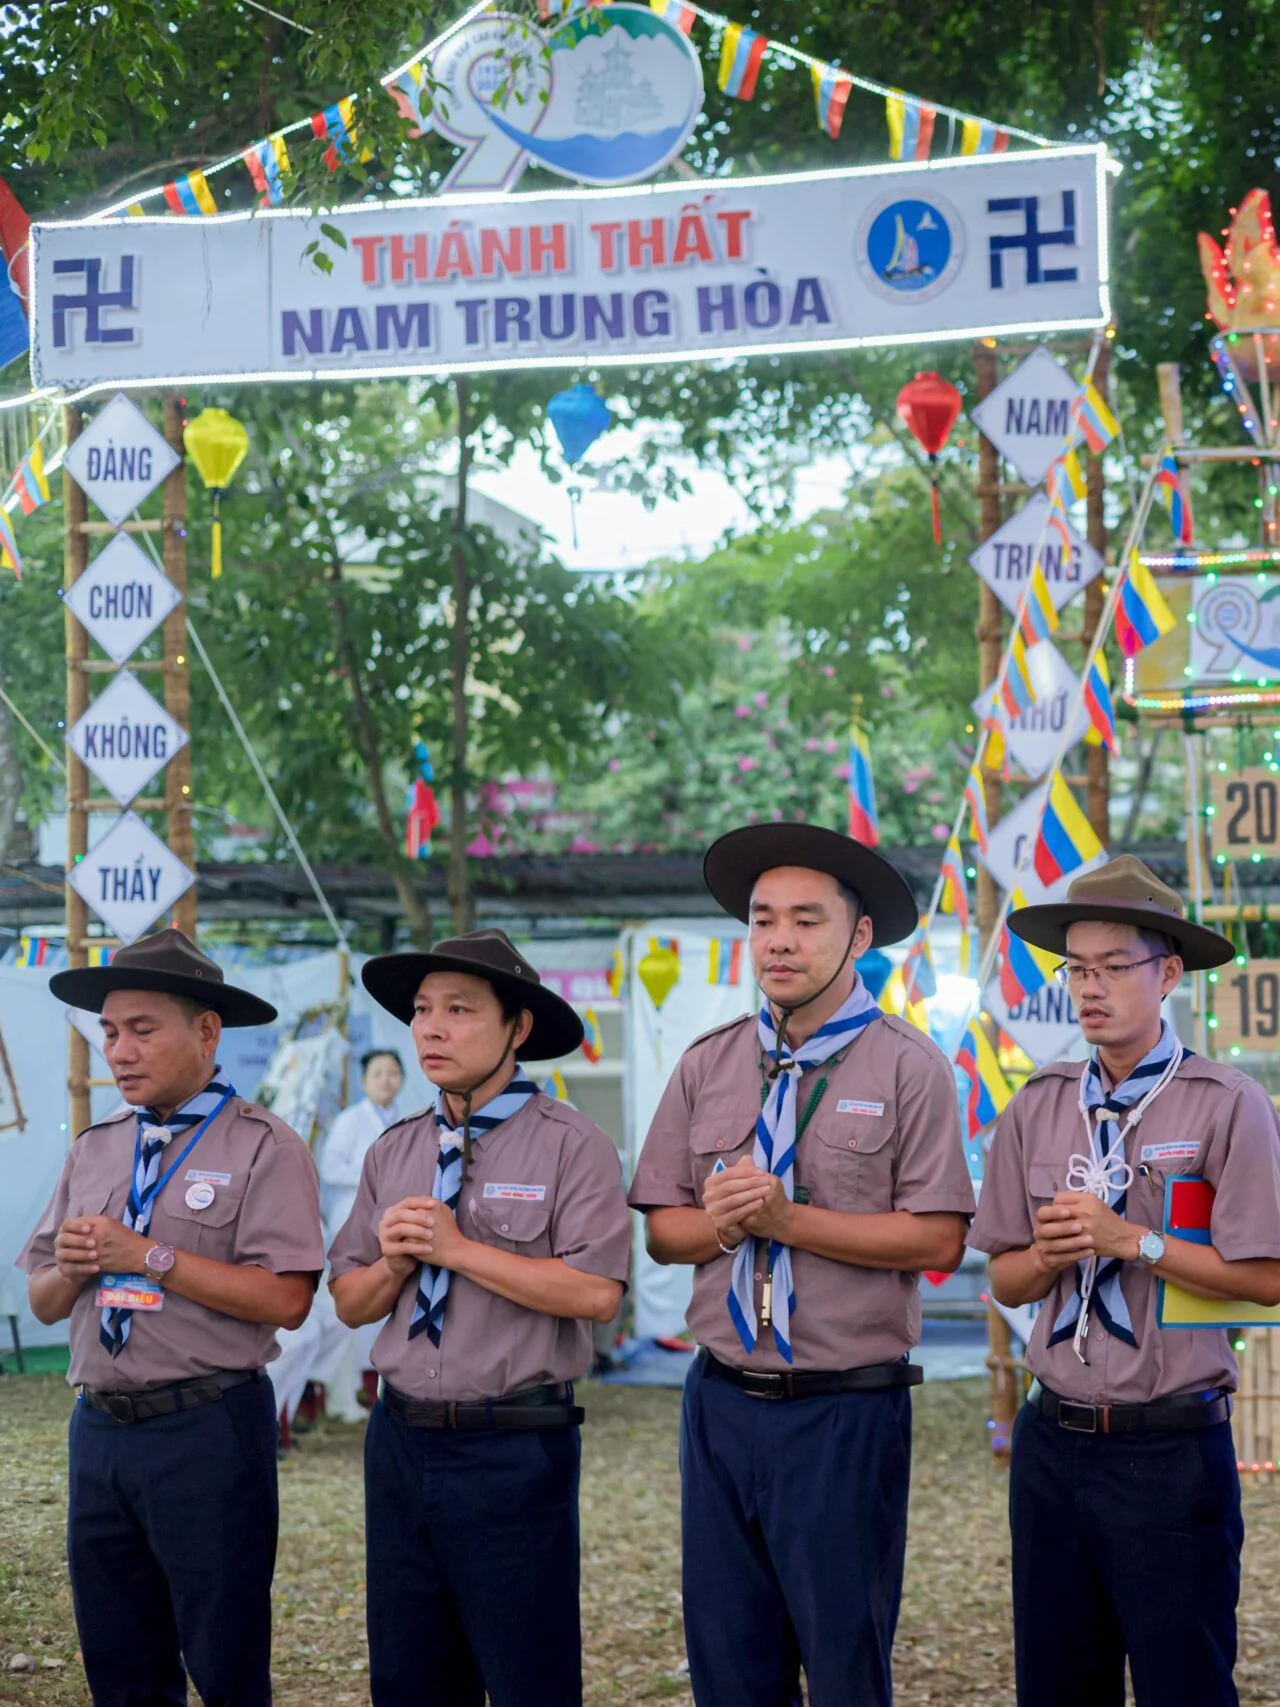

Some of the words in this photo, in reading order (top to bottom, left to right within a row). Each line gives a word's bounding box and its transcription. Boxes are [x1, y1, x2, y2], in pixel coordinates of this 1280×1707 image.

[352, 218, 568, 286] THÁNH
[590, 194, 753, 272] THẤT
[281, 302, 431, 357] NAM
[456, 288, 671, 346] TRUNG
[697, 266, 832, 334] HÒA
[1006, 398, 1069, 436] NAM
[87, 438, 152, 481] ĐÀNG
[89, 580, 153, 619] CHƠN
[84, 716, 168, 760] KHÔNG
